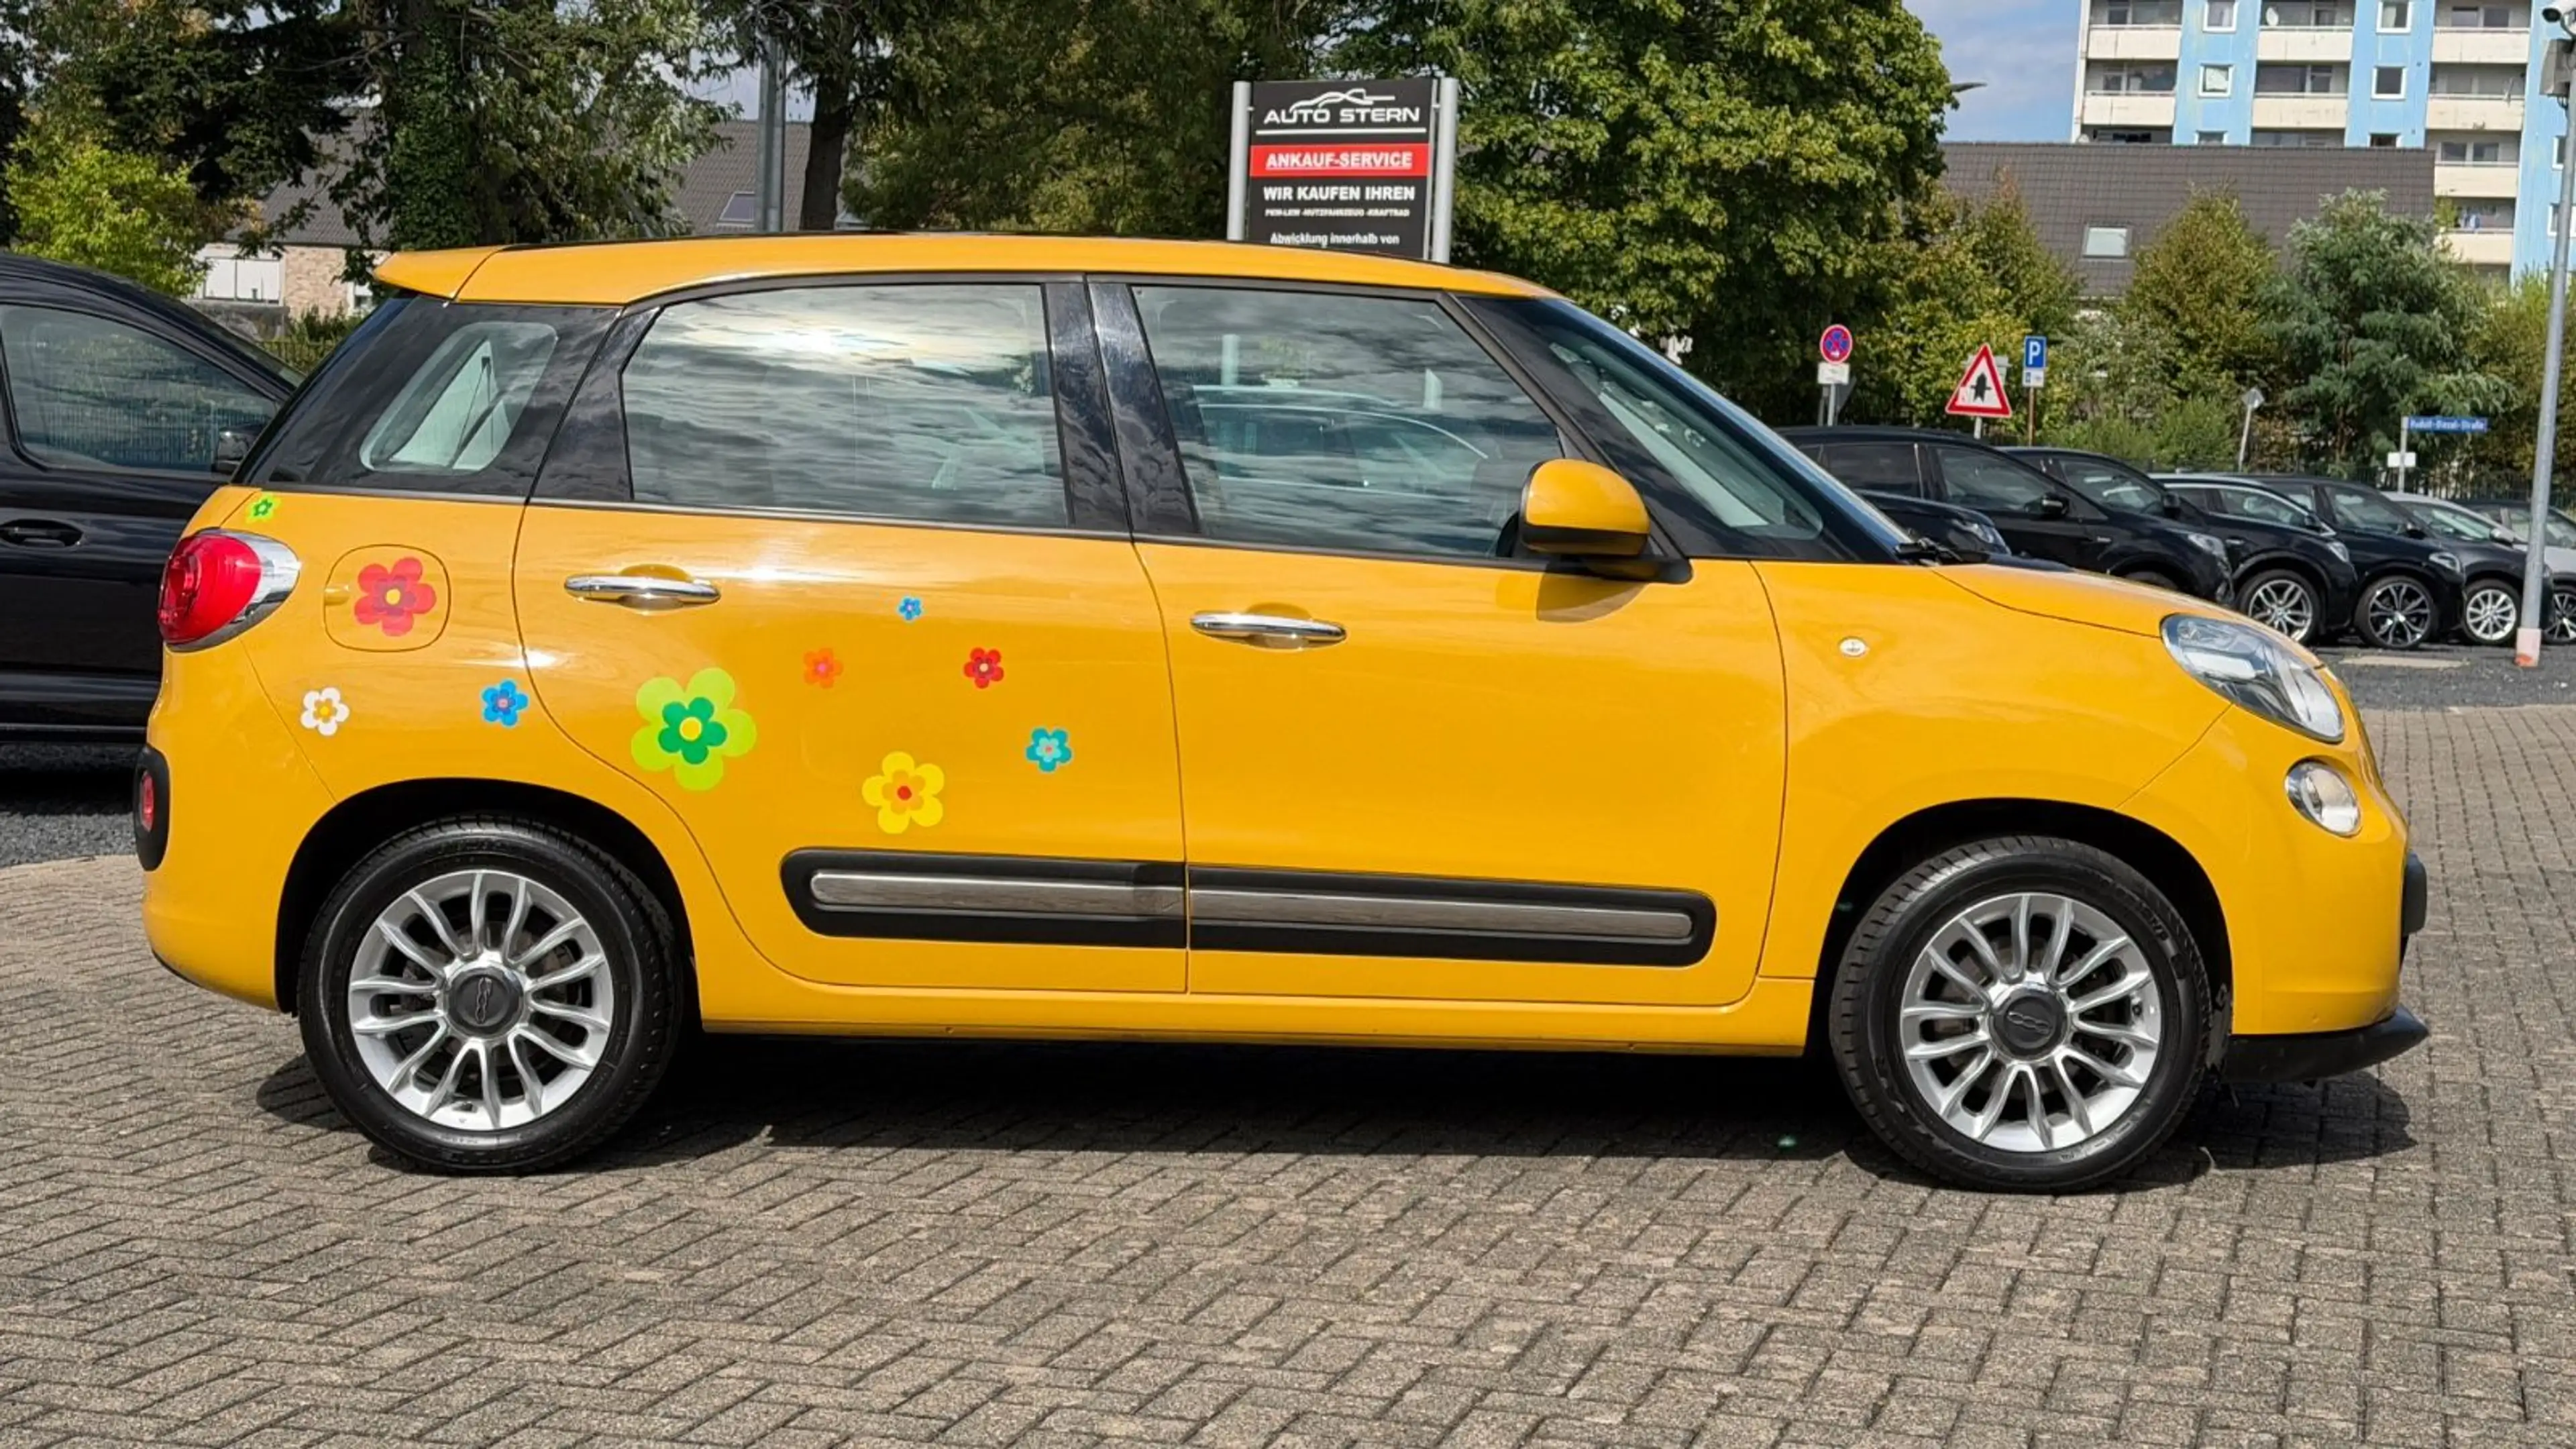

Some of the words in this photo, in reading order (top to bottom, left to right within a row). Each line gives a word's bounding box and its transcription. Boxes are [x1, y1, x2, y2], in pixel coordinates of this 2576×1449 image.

[1263, 109, 1330, 124] AUTO
[1339, 107, 1420, 123] STERN
[1266, 152, 1413, 168] ANKAUF-SERVICE
[1263, 186, 1293, 200] WIR
[1297, 186, 1360, 200] KAUFEN
[1365, 186, 1415, 200] IHREN
[1270, 232, 1328, 248] Abwicklung
[1330, 232, 1377, 244] innerhalb
[1379, 235, 1400, 244] von
[2029, 341, 2041, 365] P
